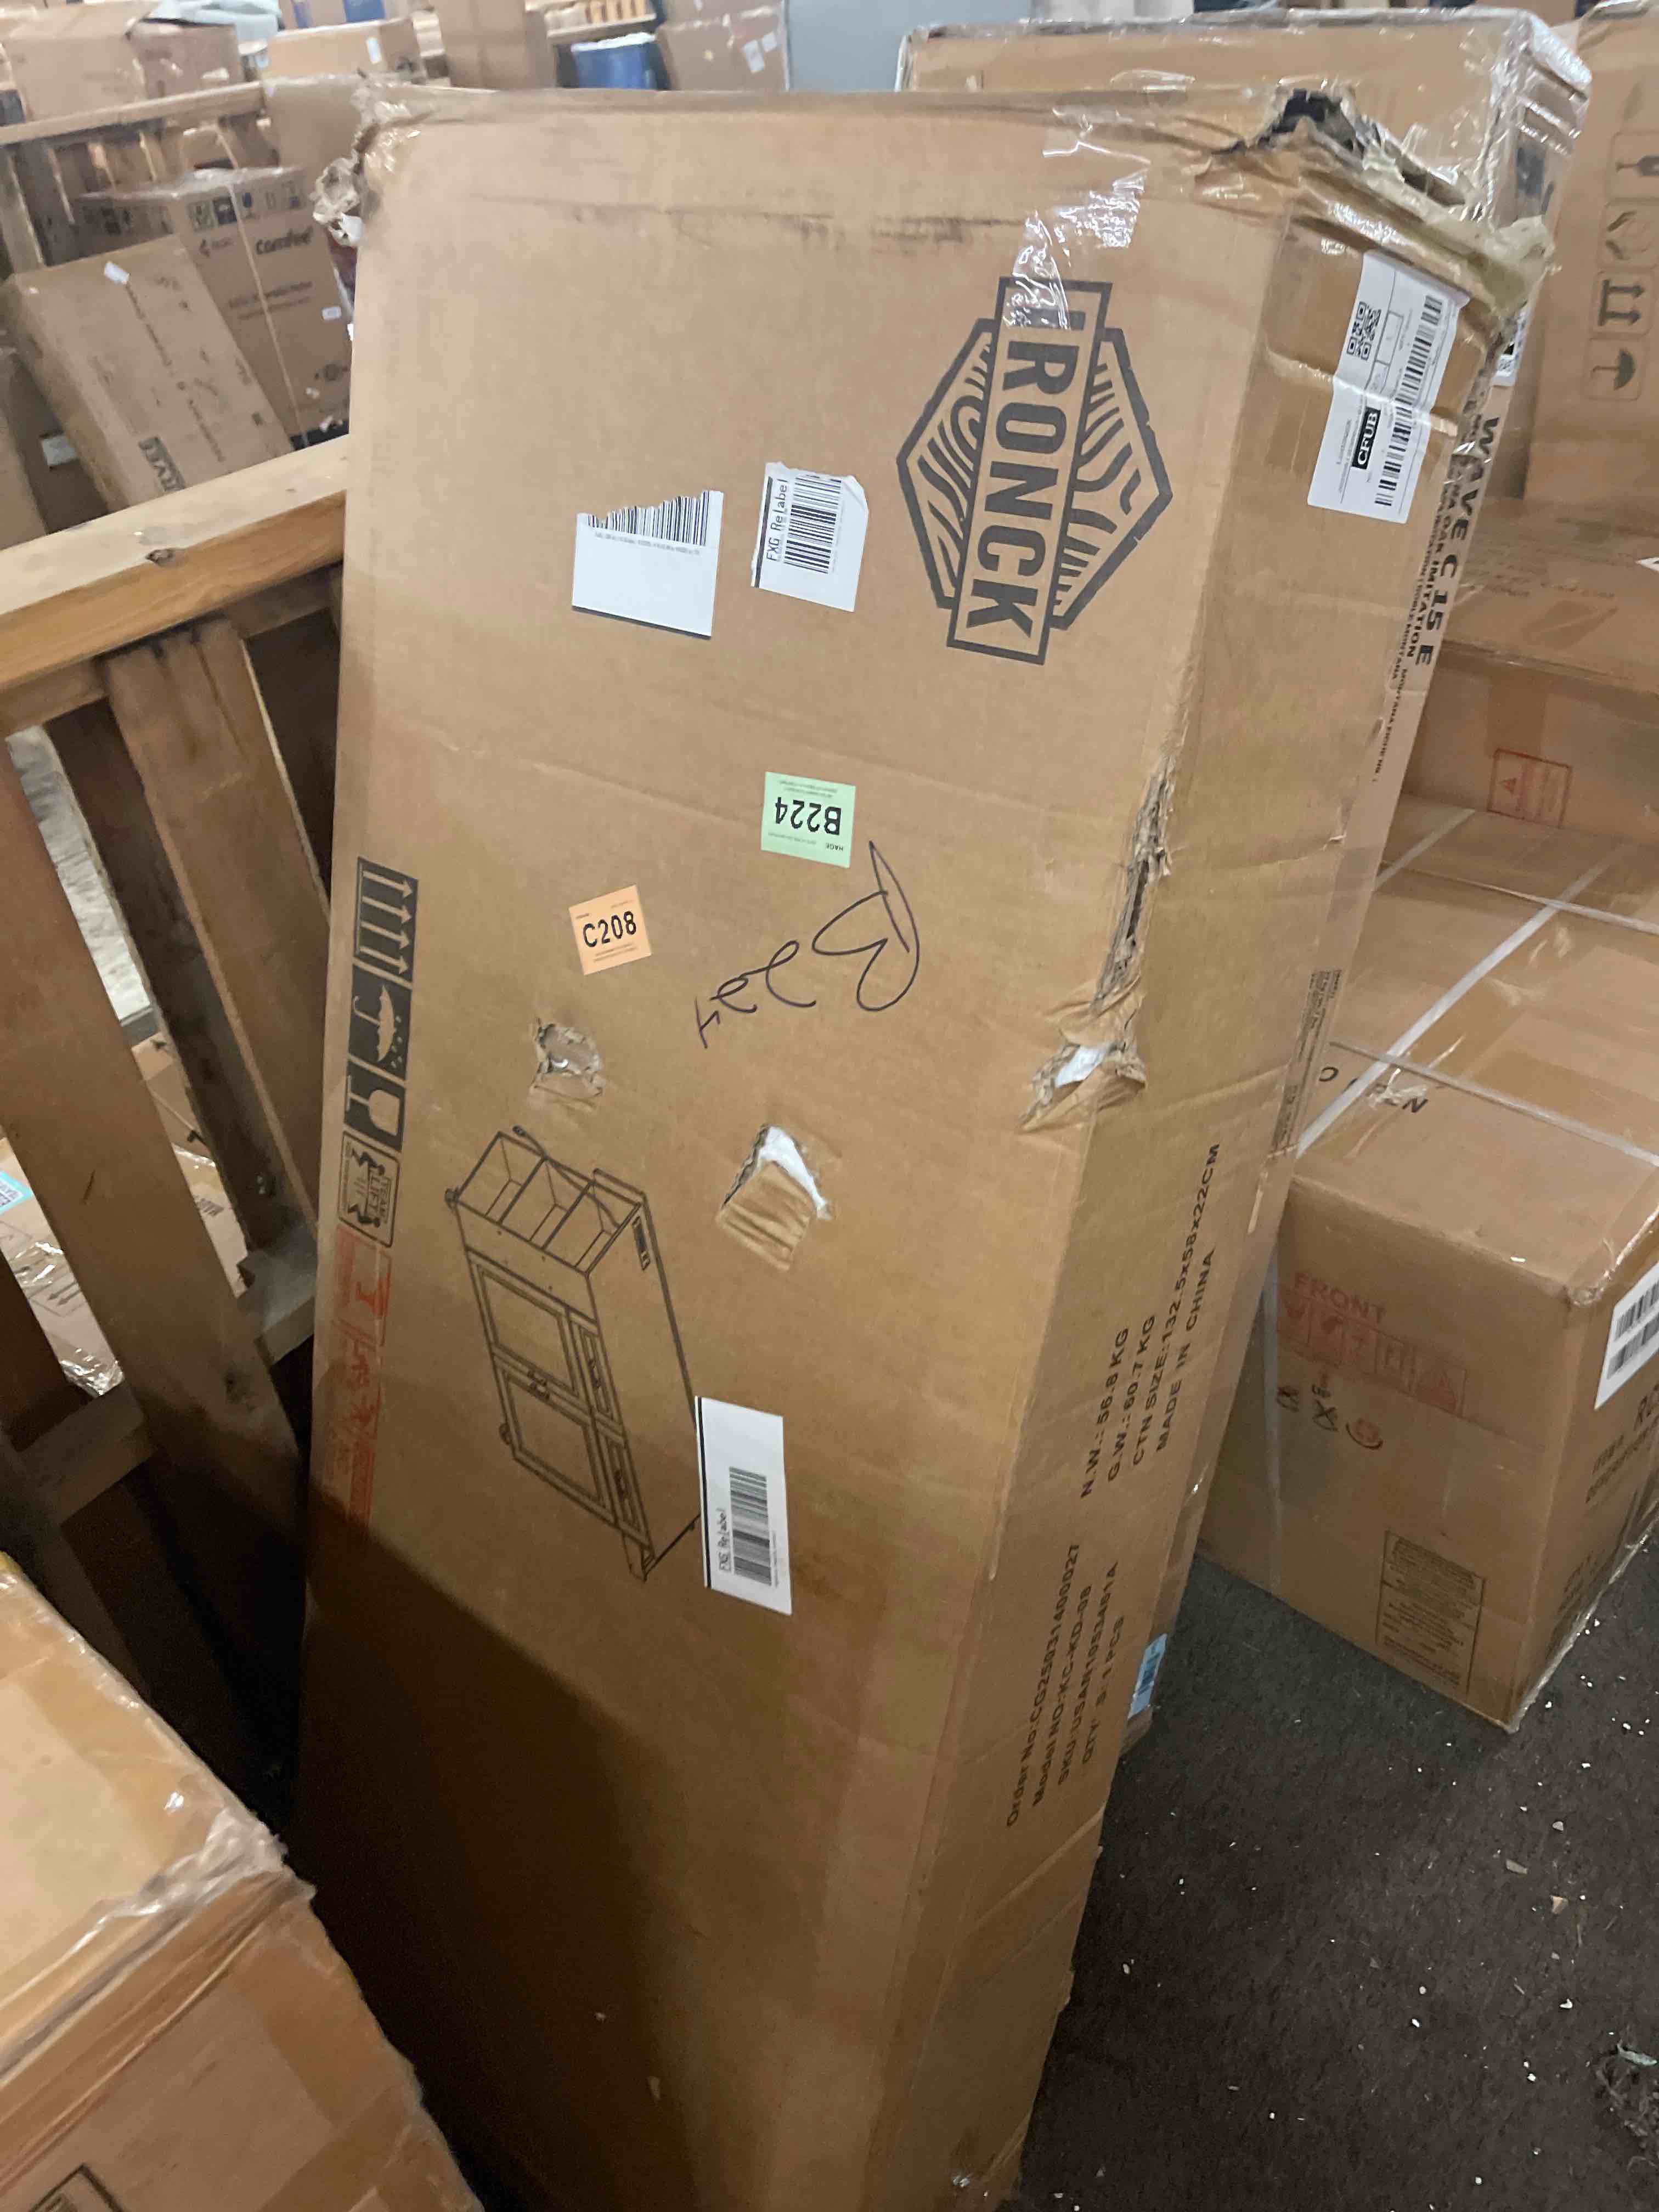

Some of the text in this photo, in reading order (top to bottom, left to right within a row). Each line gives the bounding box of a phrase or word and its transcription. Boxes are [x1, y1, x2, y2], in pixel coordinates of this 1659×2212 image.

[966, 309, 1086, 638] IRONCK
[766, 537, 780, 562] FXG
[1441, 554, 1458, 578] C
[1426, 590, 1448, 631] 15
[1415, 645, 1434, 665] E
[774, 797, 842, 836] B224
[583, 911, 637, 948] C208
[1156, 1245, 1216, 1452] MADE IN CHINA
[1133, 1414, 1153, 1465] CTN
